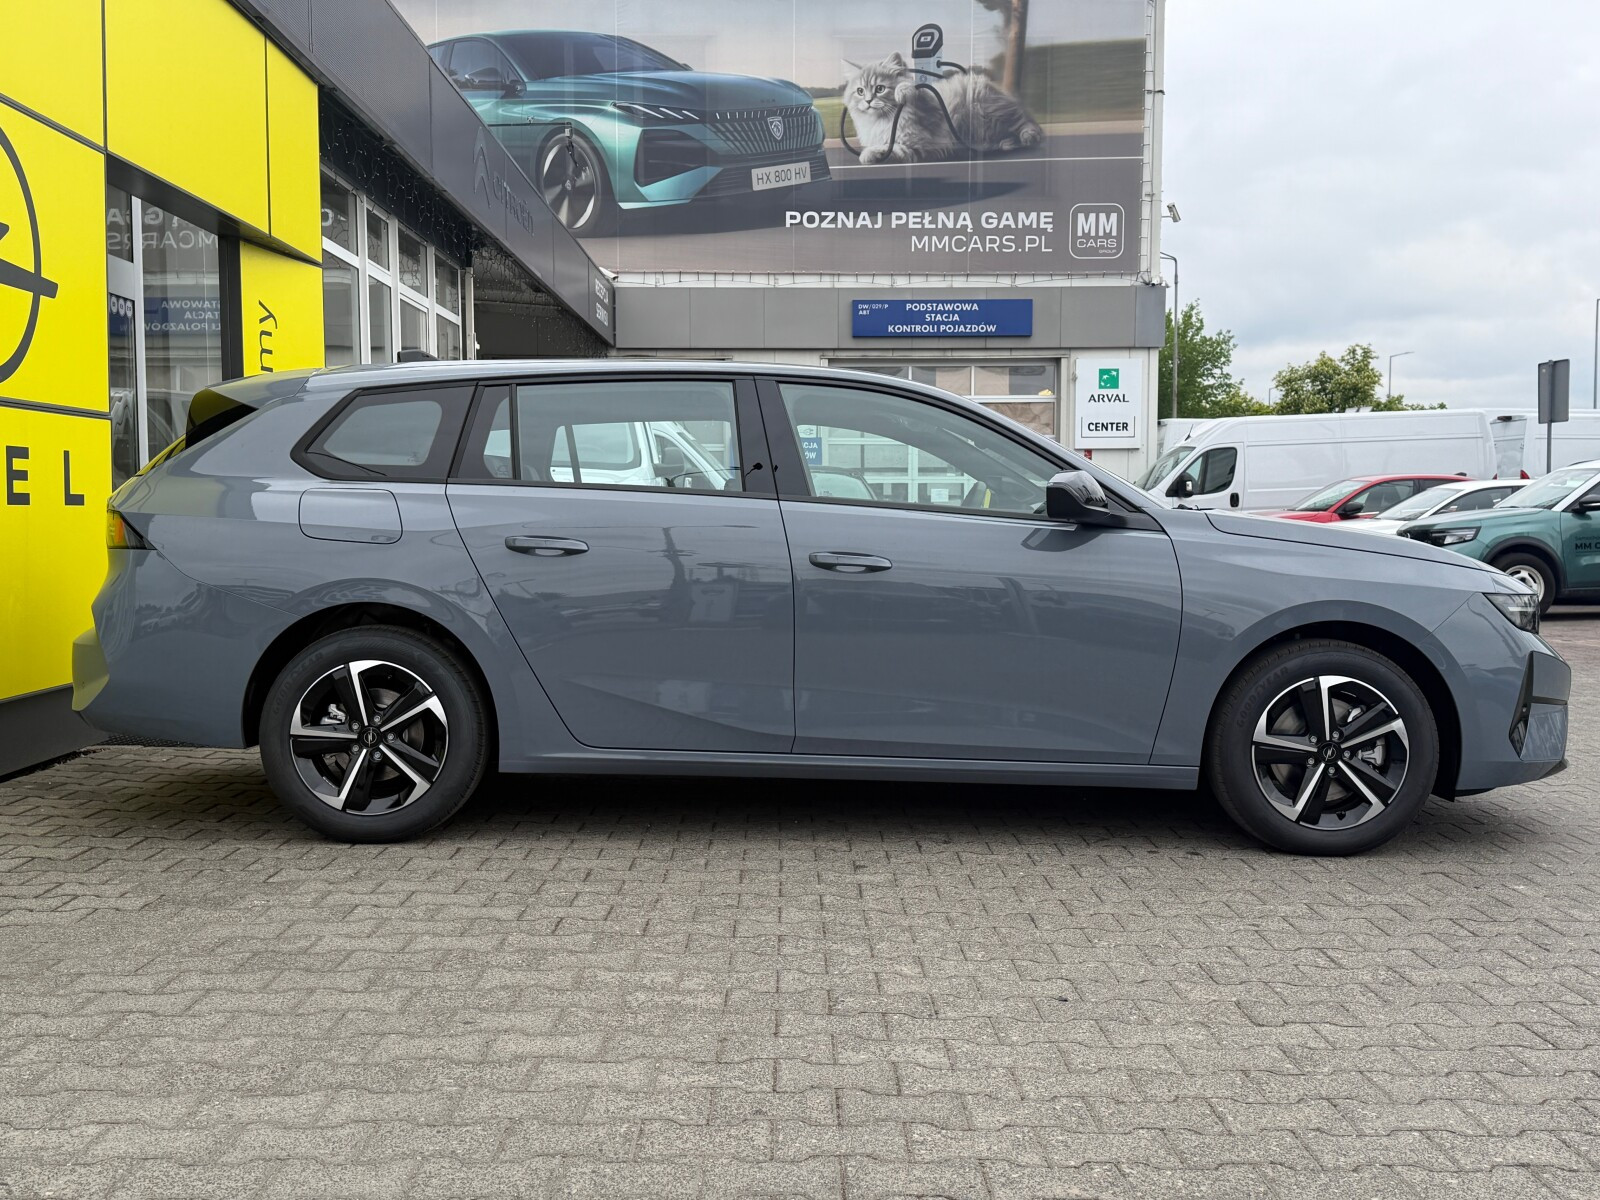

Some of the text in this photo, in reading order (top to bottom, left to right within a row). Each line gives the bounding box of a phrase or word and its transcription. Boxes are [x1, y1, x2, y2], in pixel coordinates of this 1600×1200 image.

[757, 166, 807, 186] HX 800 HV
[785, 211, 1055, 233] POZNAJ PEŁNĄ GAMĘ
[1077, 212, 1118, 237] MM
[911, 235, 1053, 253] MMCARS.PL
[1076, 238, 1117, 248] CARS
[905, 303, 979, 311] PODSTAWOWA
[925, 313, 960, 322] STACJA
[887, 322, 997, 333] KONTROLI POJAZDÓW
[1087, 393, 1130, 403] ARVAL
[1087, 421, 1129, 432] CENTER
[1575, 542, 1592, 550] MM
